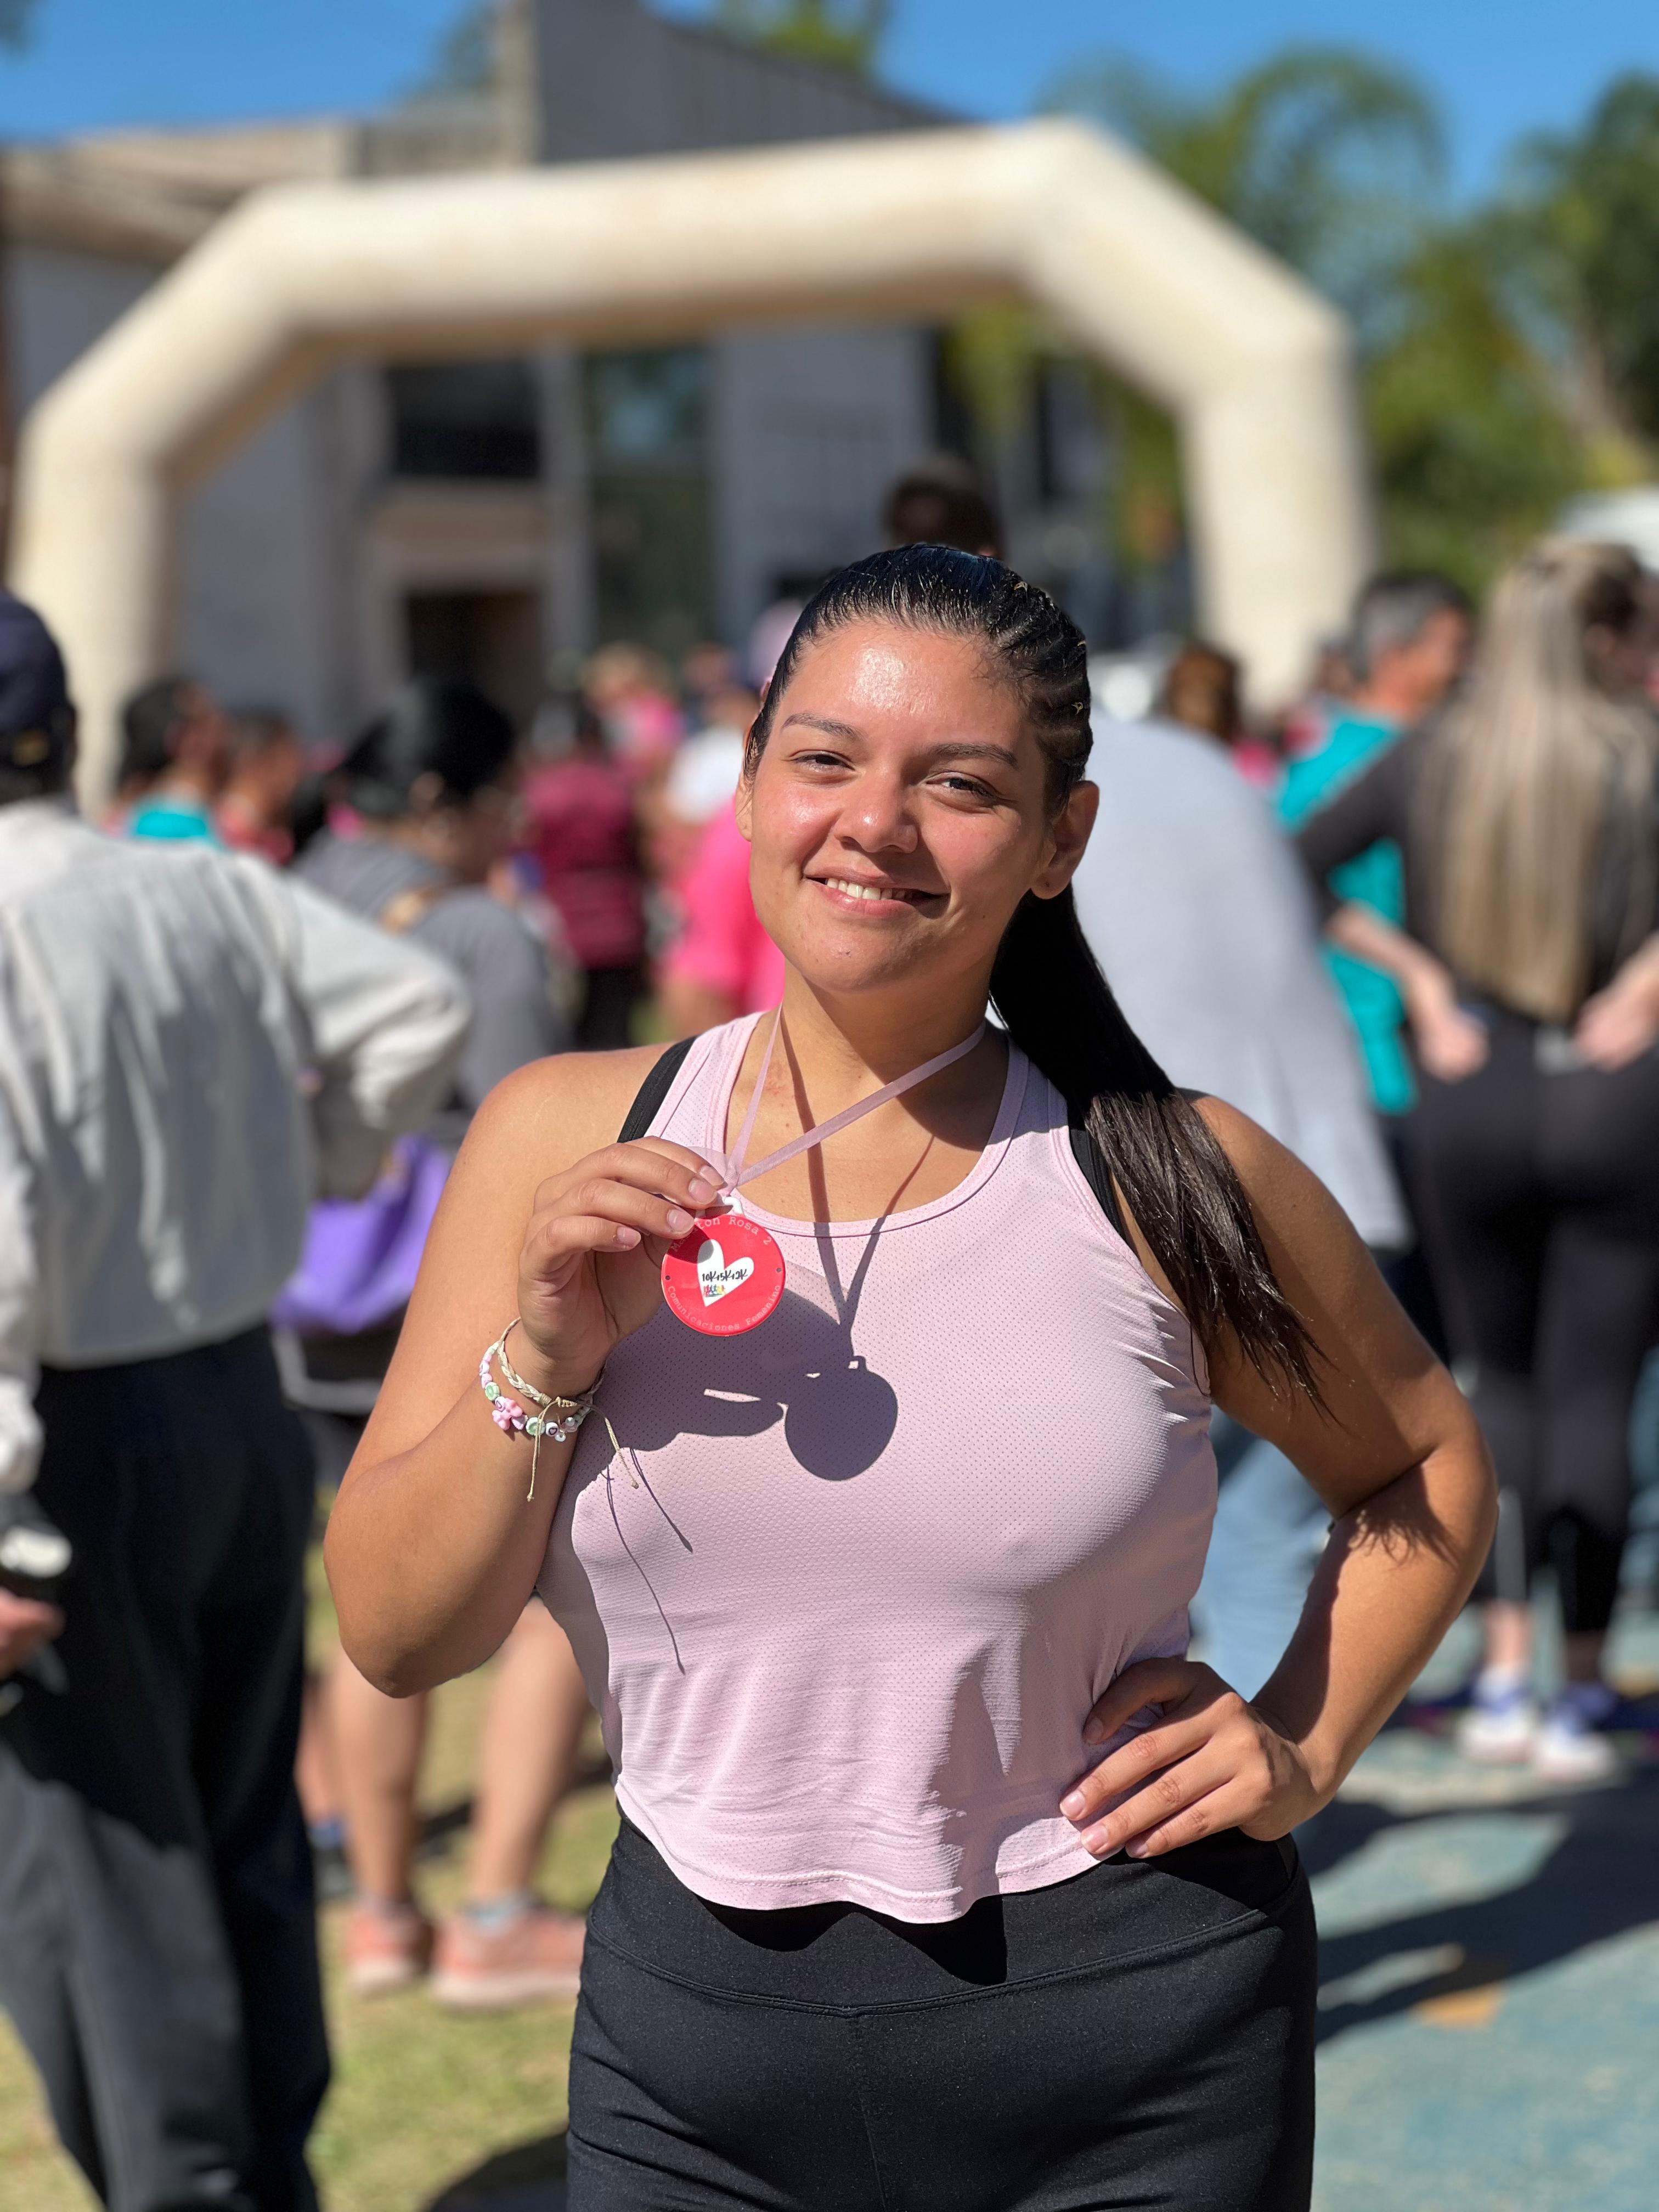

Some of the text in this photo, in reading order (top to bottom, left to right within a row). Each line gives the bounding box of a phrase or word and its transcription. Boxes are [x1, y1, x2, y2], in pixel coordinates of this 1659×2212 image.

[729, 1216, 759, 1235] Rosa
[668, 1285, 781, 1331] Comunicaciones Femenino
